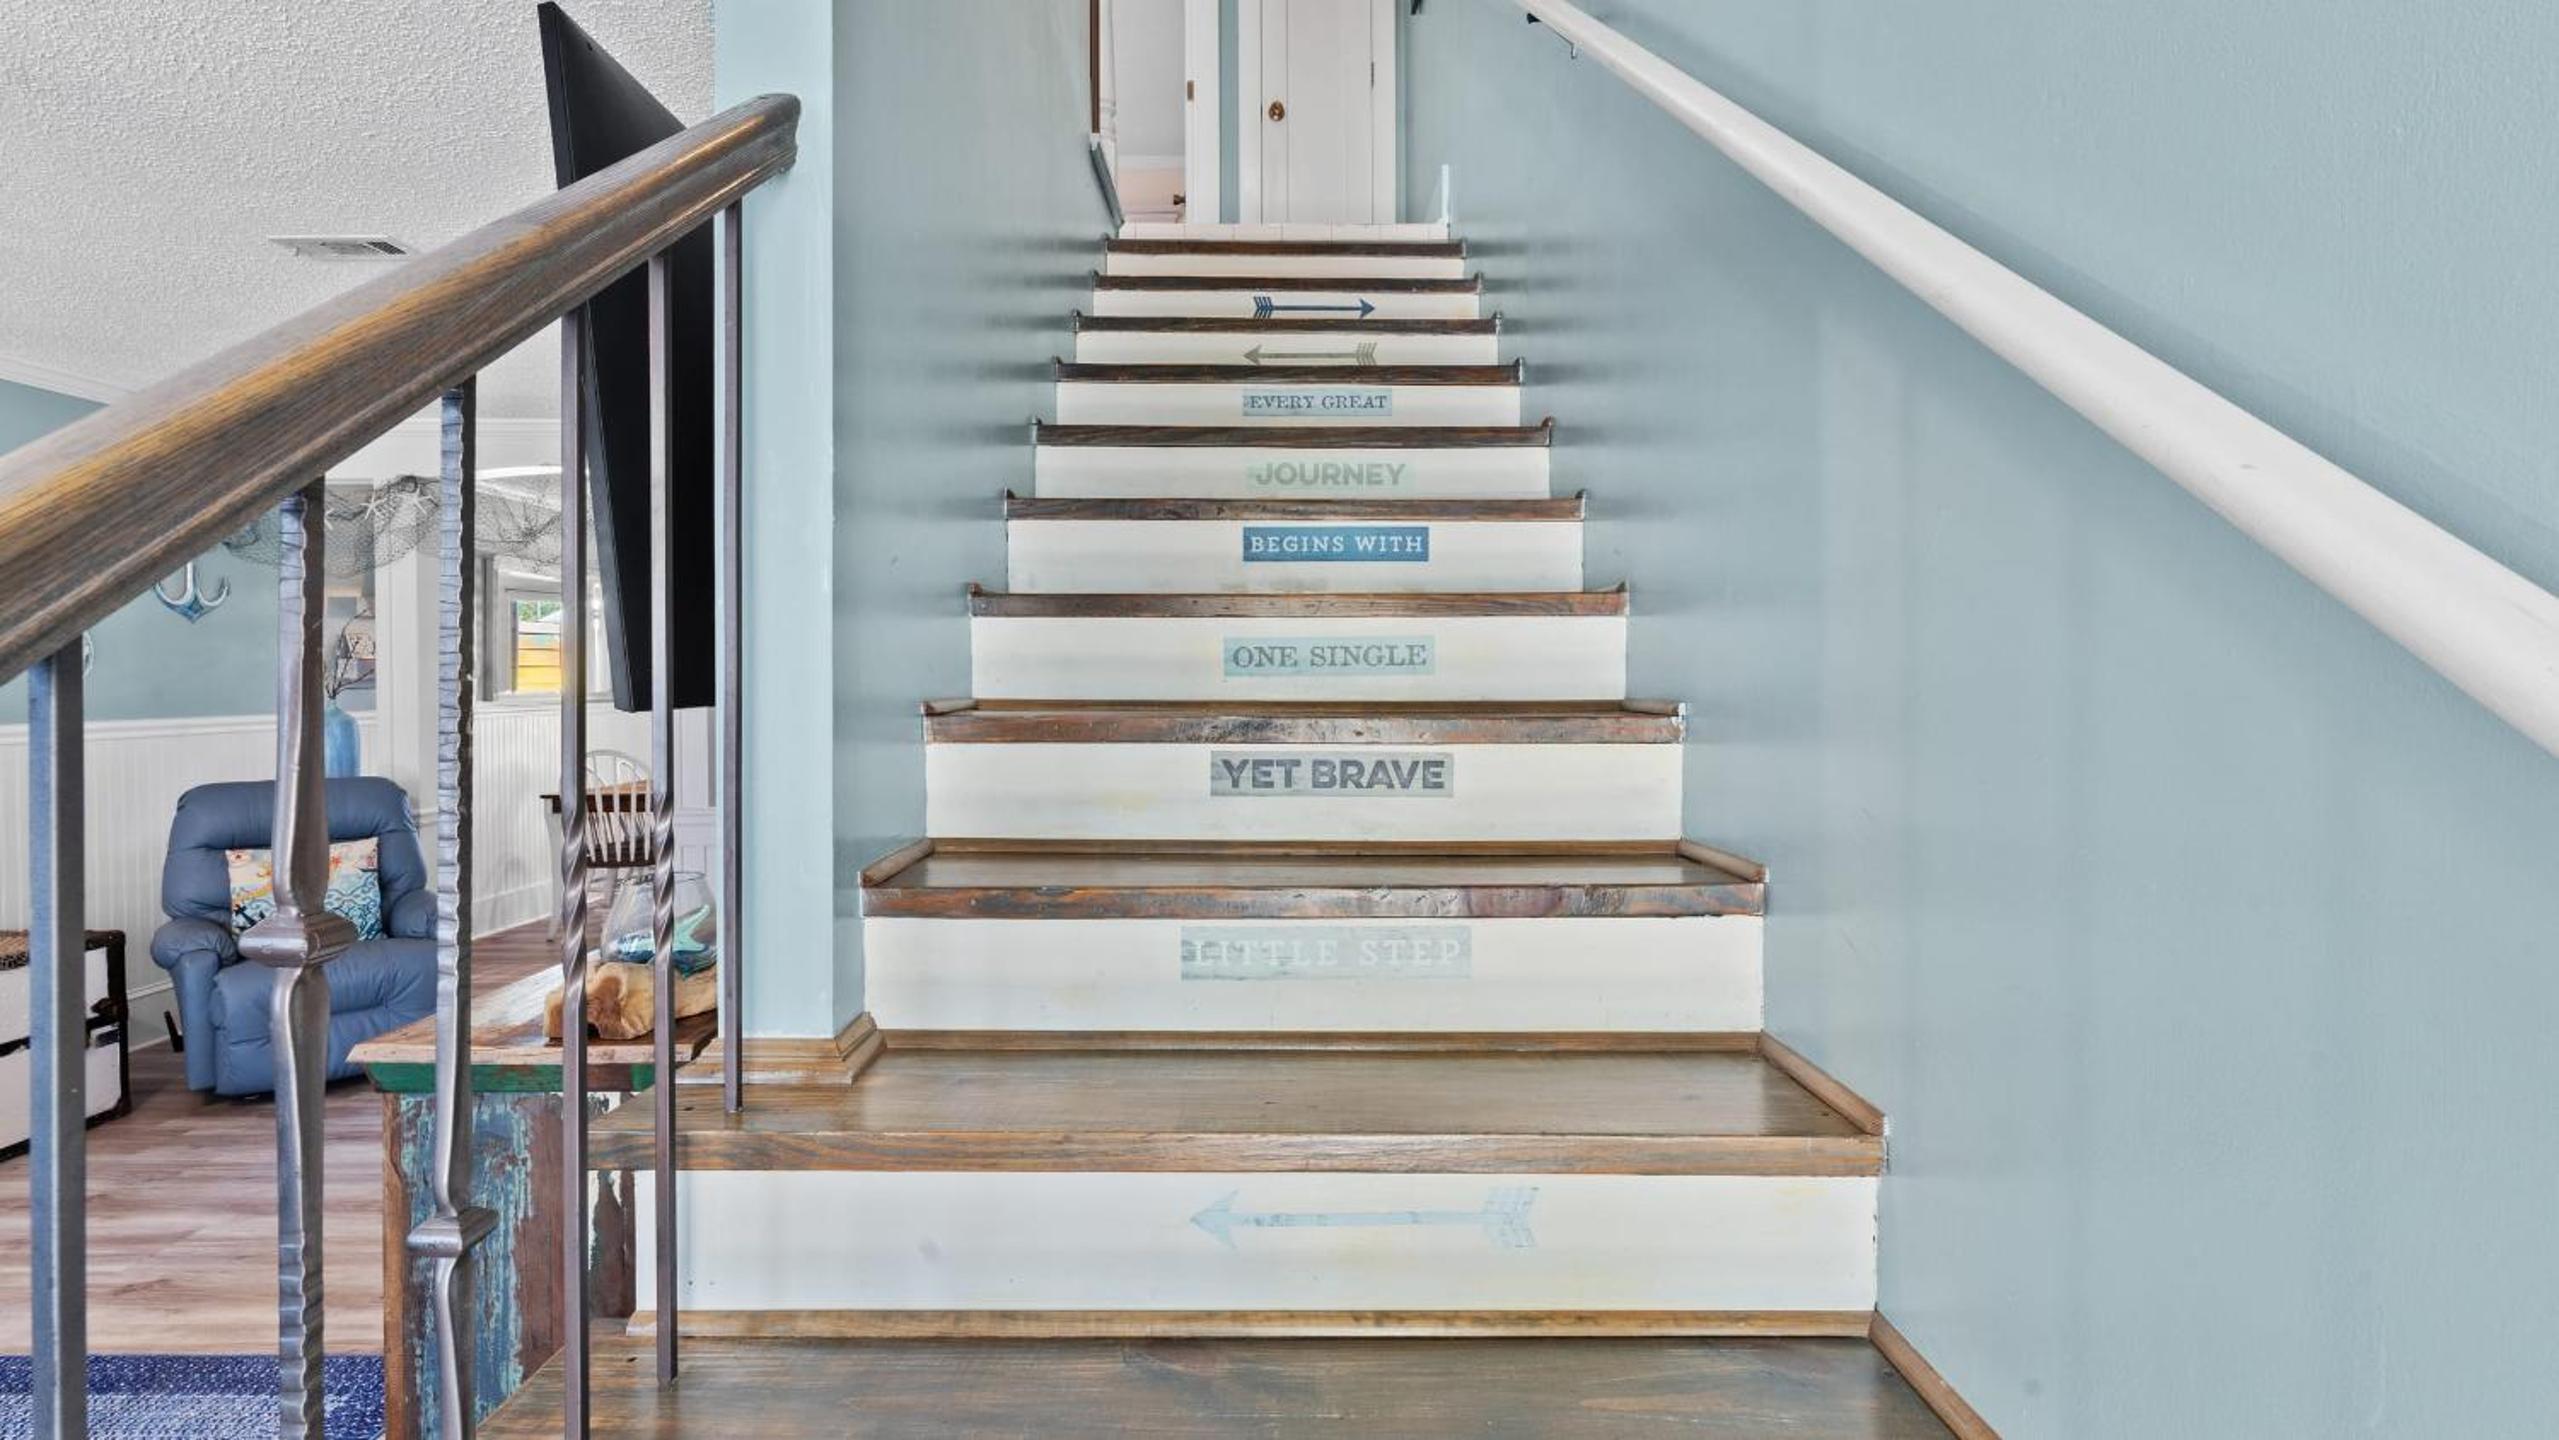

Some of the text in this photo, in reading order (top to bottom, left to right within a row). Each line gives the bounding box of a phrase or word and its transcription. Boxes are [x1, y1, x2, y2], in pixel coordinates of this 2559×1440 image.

[1250, 394, 1387, 410] EVERY GREAT
[1256, 464, 1405, 485] JOURNEY
[1251, 535, 1423, 553] BEGINS WITH
[1233, 645, 1427, 669] ONE SINGLE
[1221, 758, 1445, 790] YET BRAVE
[1193, 940, 1460, 966] LITTLE STEP
